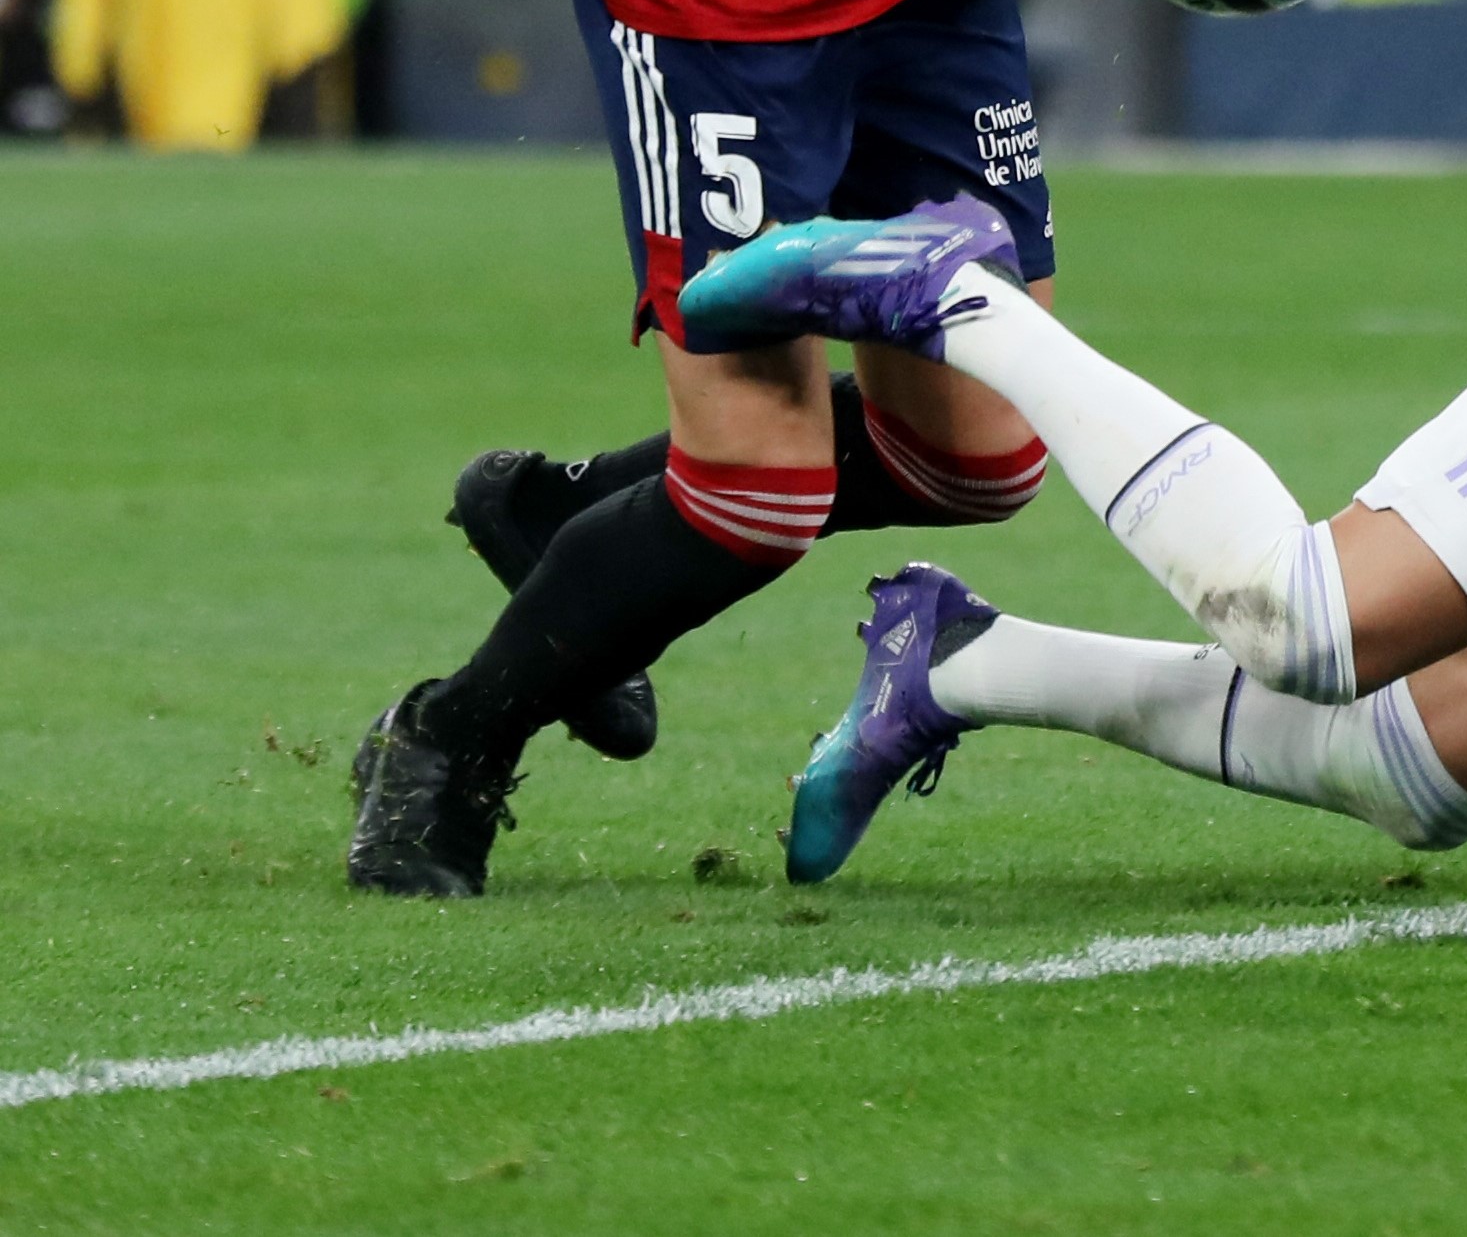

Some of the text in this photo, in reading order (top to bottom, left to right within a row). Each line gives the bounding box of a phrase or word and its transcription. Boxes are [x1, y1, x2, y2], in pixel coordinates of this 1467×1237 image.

[974, 99, 1033, 133] Clínica
[690, 112, 764, 239] 5
[984, 160, 1010, 187] de
